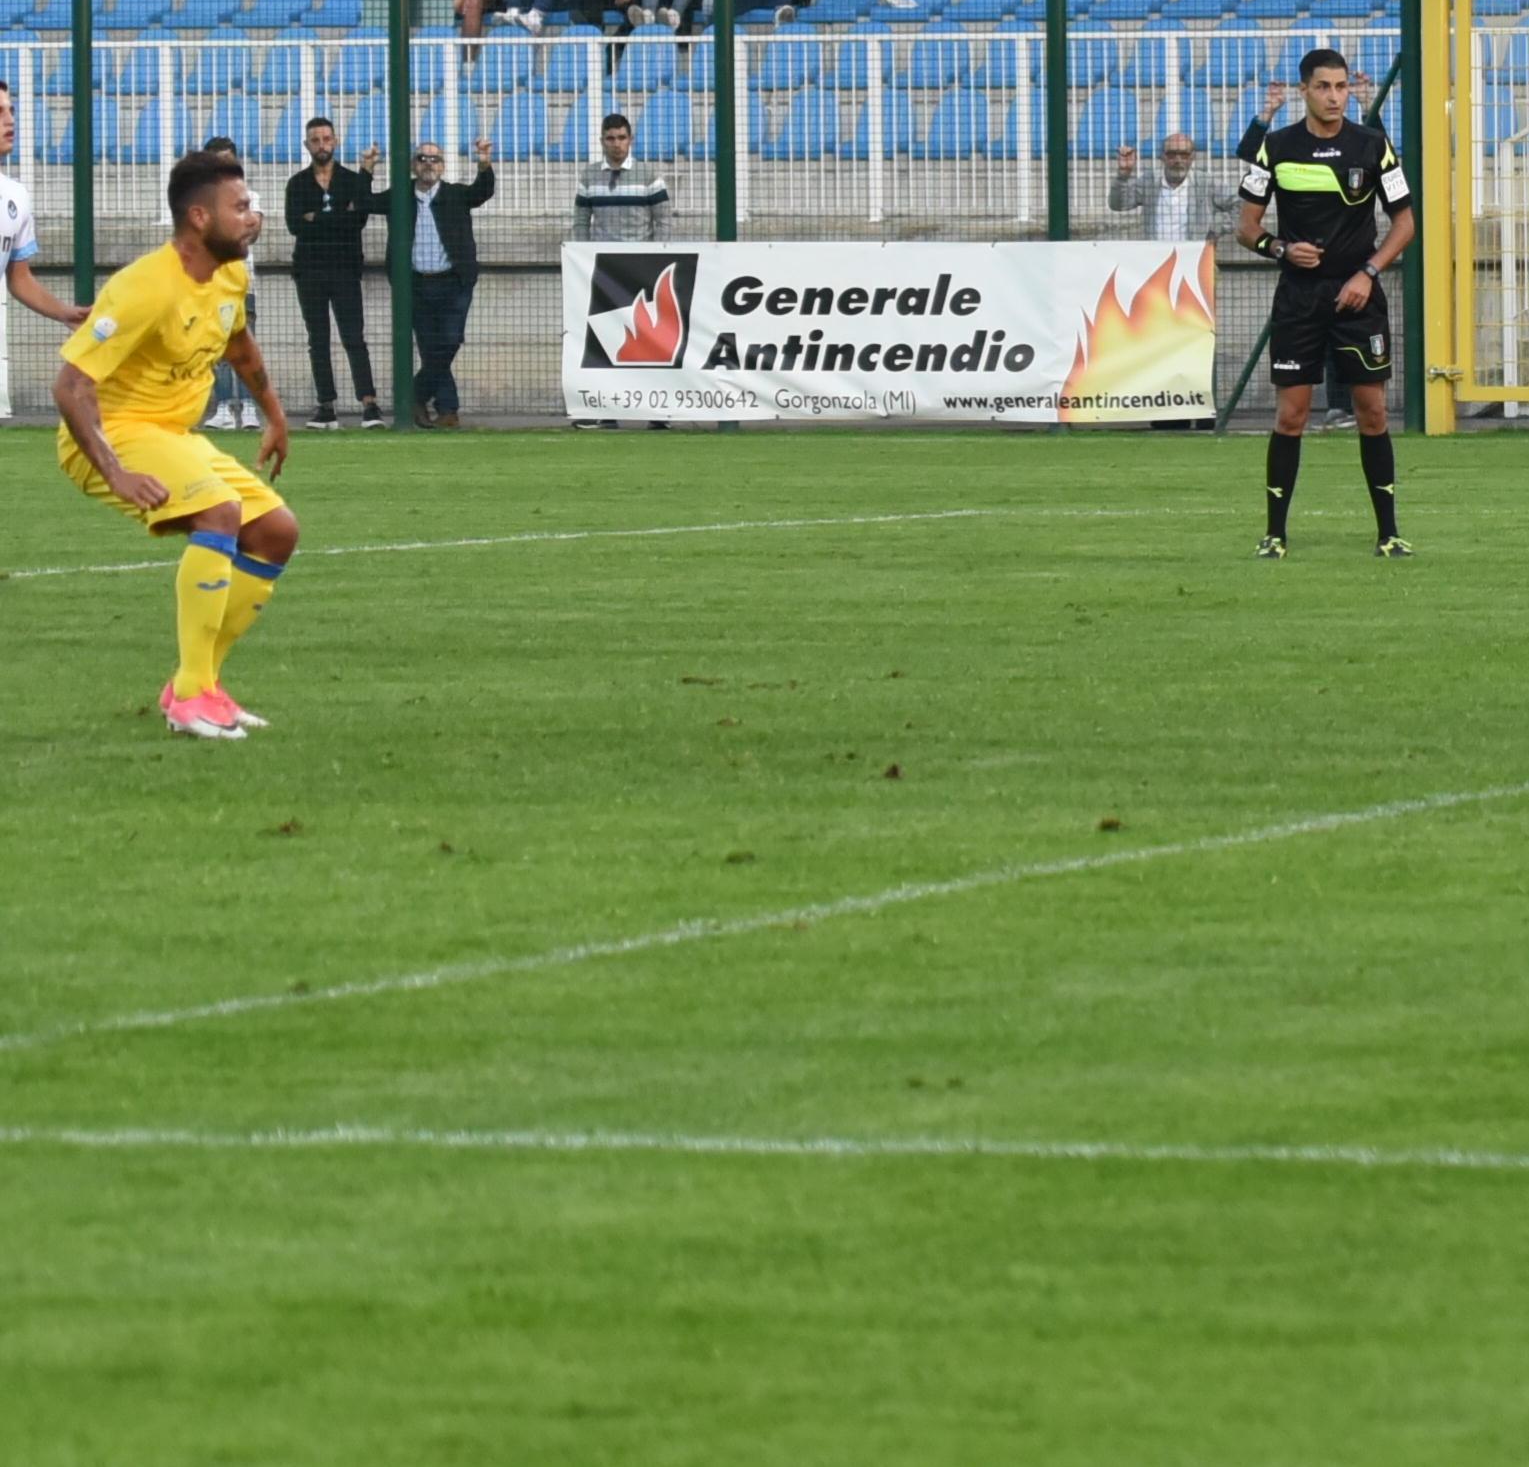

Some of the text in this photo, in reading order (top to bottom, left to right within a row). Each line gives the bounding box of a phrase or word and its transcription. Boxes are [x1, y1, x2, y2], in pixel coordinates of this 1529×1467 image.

[721, 273, 981, 316] Generale
[701, 329, 1035, 372] Antincendio
[578, 388, 1206, 416] Tel: +39 02 95300642 Gorgonzola (MI) www.generaleantincendio.it
